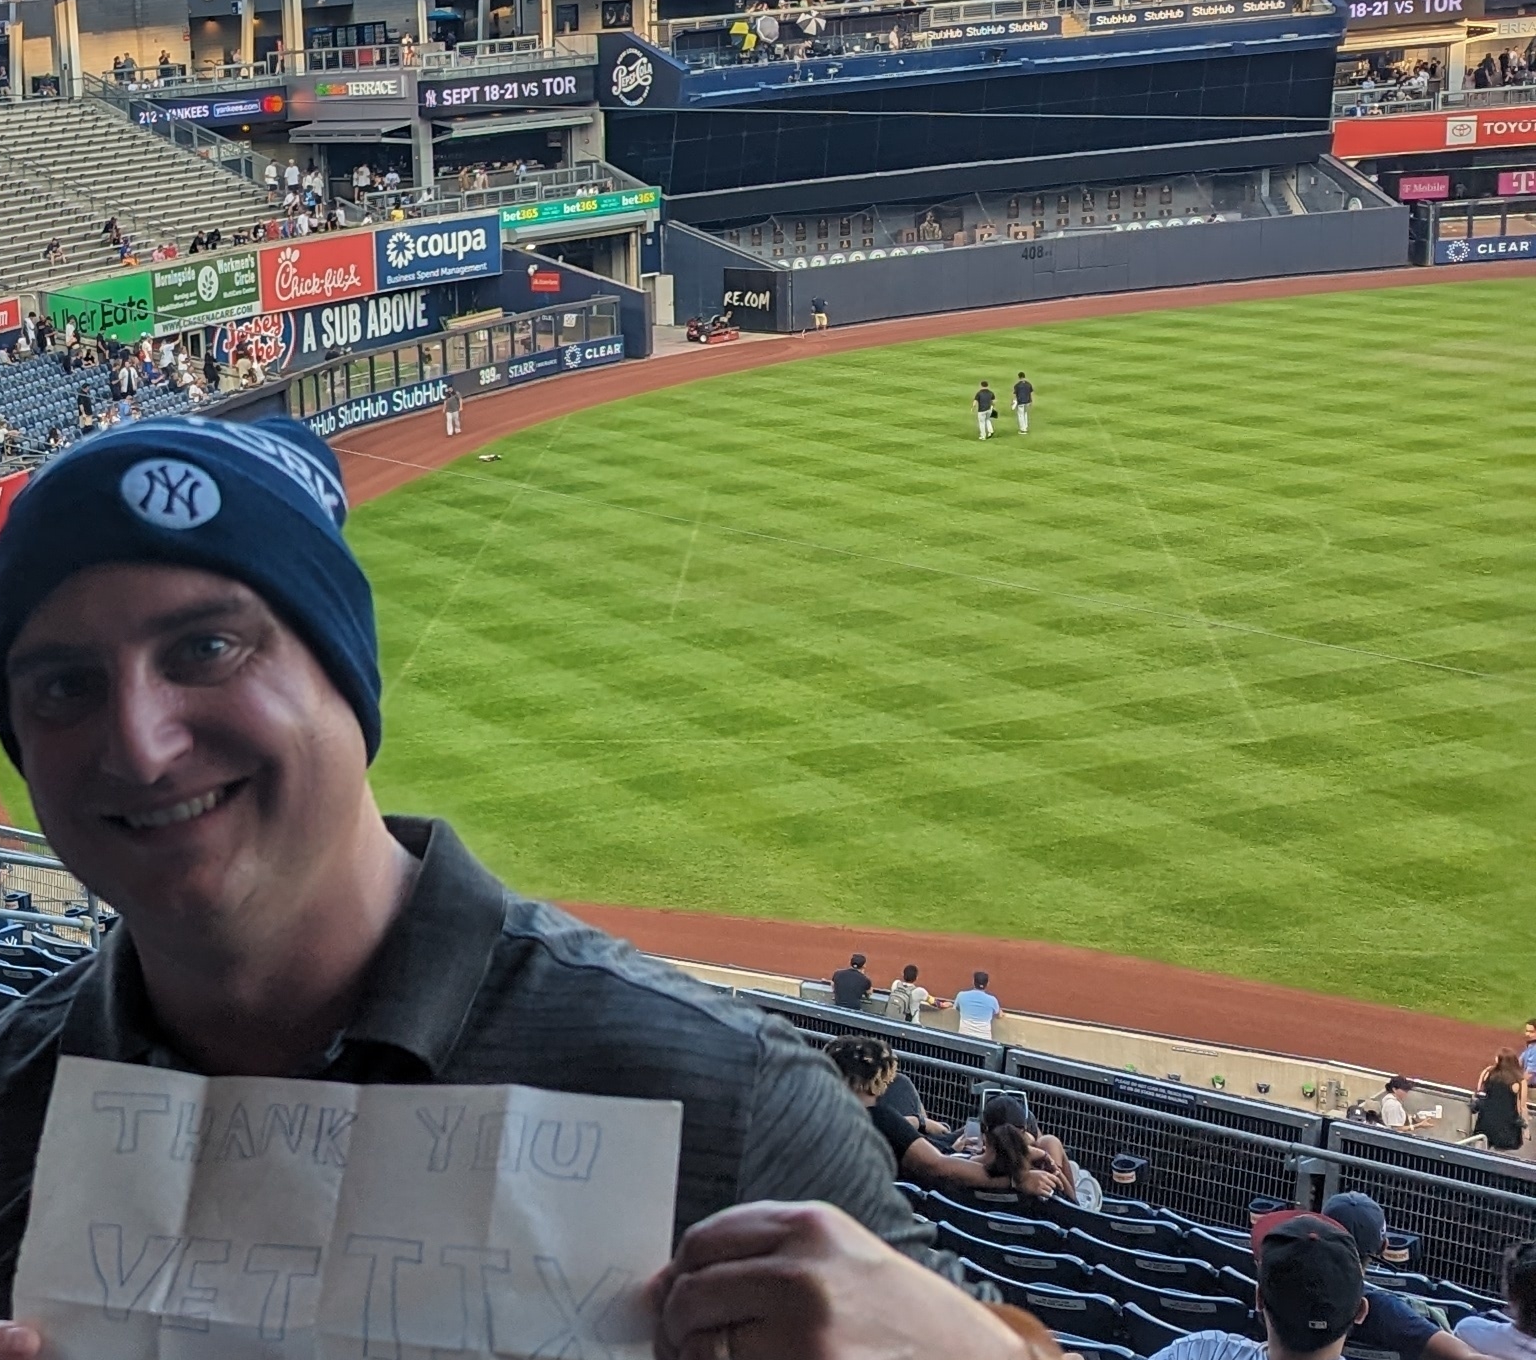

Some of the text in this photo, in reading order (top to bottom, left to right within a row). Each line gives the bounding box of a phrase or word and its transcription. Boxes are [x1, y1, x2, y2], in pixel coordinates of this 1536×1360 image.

[1097, 0, 1285, 25] StubHub StubHub StubHub StubHub
[1349, 1, 1388, 18] 18-21
[966, 26, 1005, 37] StubHub
[1009, 21, 1048, 33] StubHub
[346, 80, 398, 95] TERRACE
[442, 86, 480, 105] SEPT
[484, 82, 518, 101] 18-21
[542, 76, 576, 96] TOR
[139, 111, 157, 125] 212
[165, 105, 209, 121] YANKEES
[564, 200, 598, 213] bet365
[622, 192, 654, 206] bet365
[503, 208, 538, 222] bet365
[417, 228, 487, 261] coupa
[1022, 246, 1043, 260] 408
[1478, 241, 1529, 254] CLEAR
[276, 257, 362, 301] Chick-fil-A
[387, 262, 487, 285] Business Spend Management
[724, 291, 770, 311] RE.COM
[101, 296, 148, 329] Eats
[303, 312, 317, 353] A
[322, 303, 361, 349] SUB
[367, 290, 429, 339] ABOVE
[585, 344, 620, 360] CLEAR
[479, 367, 496, 386] 399
[509, 361, 535, 378] STARR
[338, 380, 447, 429] StubHub StubHub
[93, 1091, 602, 1181] THANK YOU
